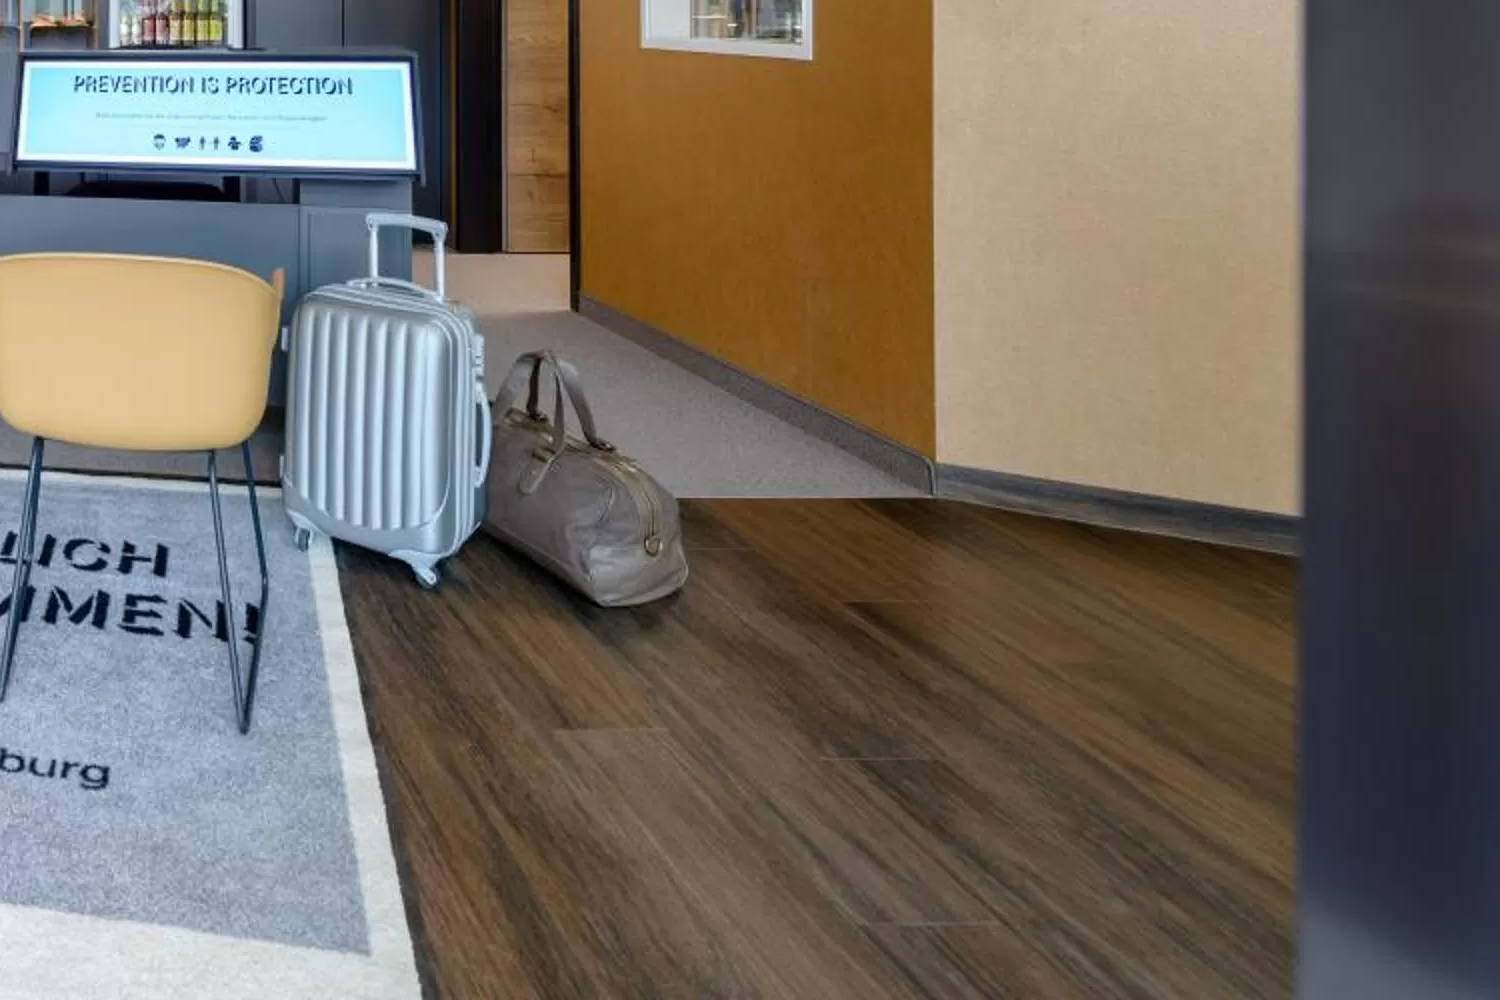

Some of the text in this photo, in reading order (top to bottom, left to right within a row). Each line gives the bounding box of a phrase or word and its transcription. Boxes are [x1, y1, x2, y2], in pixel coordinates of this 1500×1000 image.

[73, 75, 353, 95] PREVENTION IS PROTECTION
